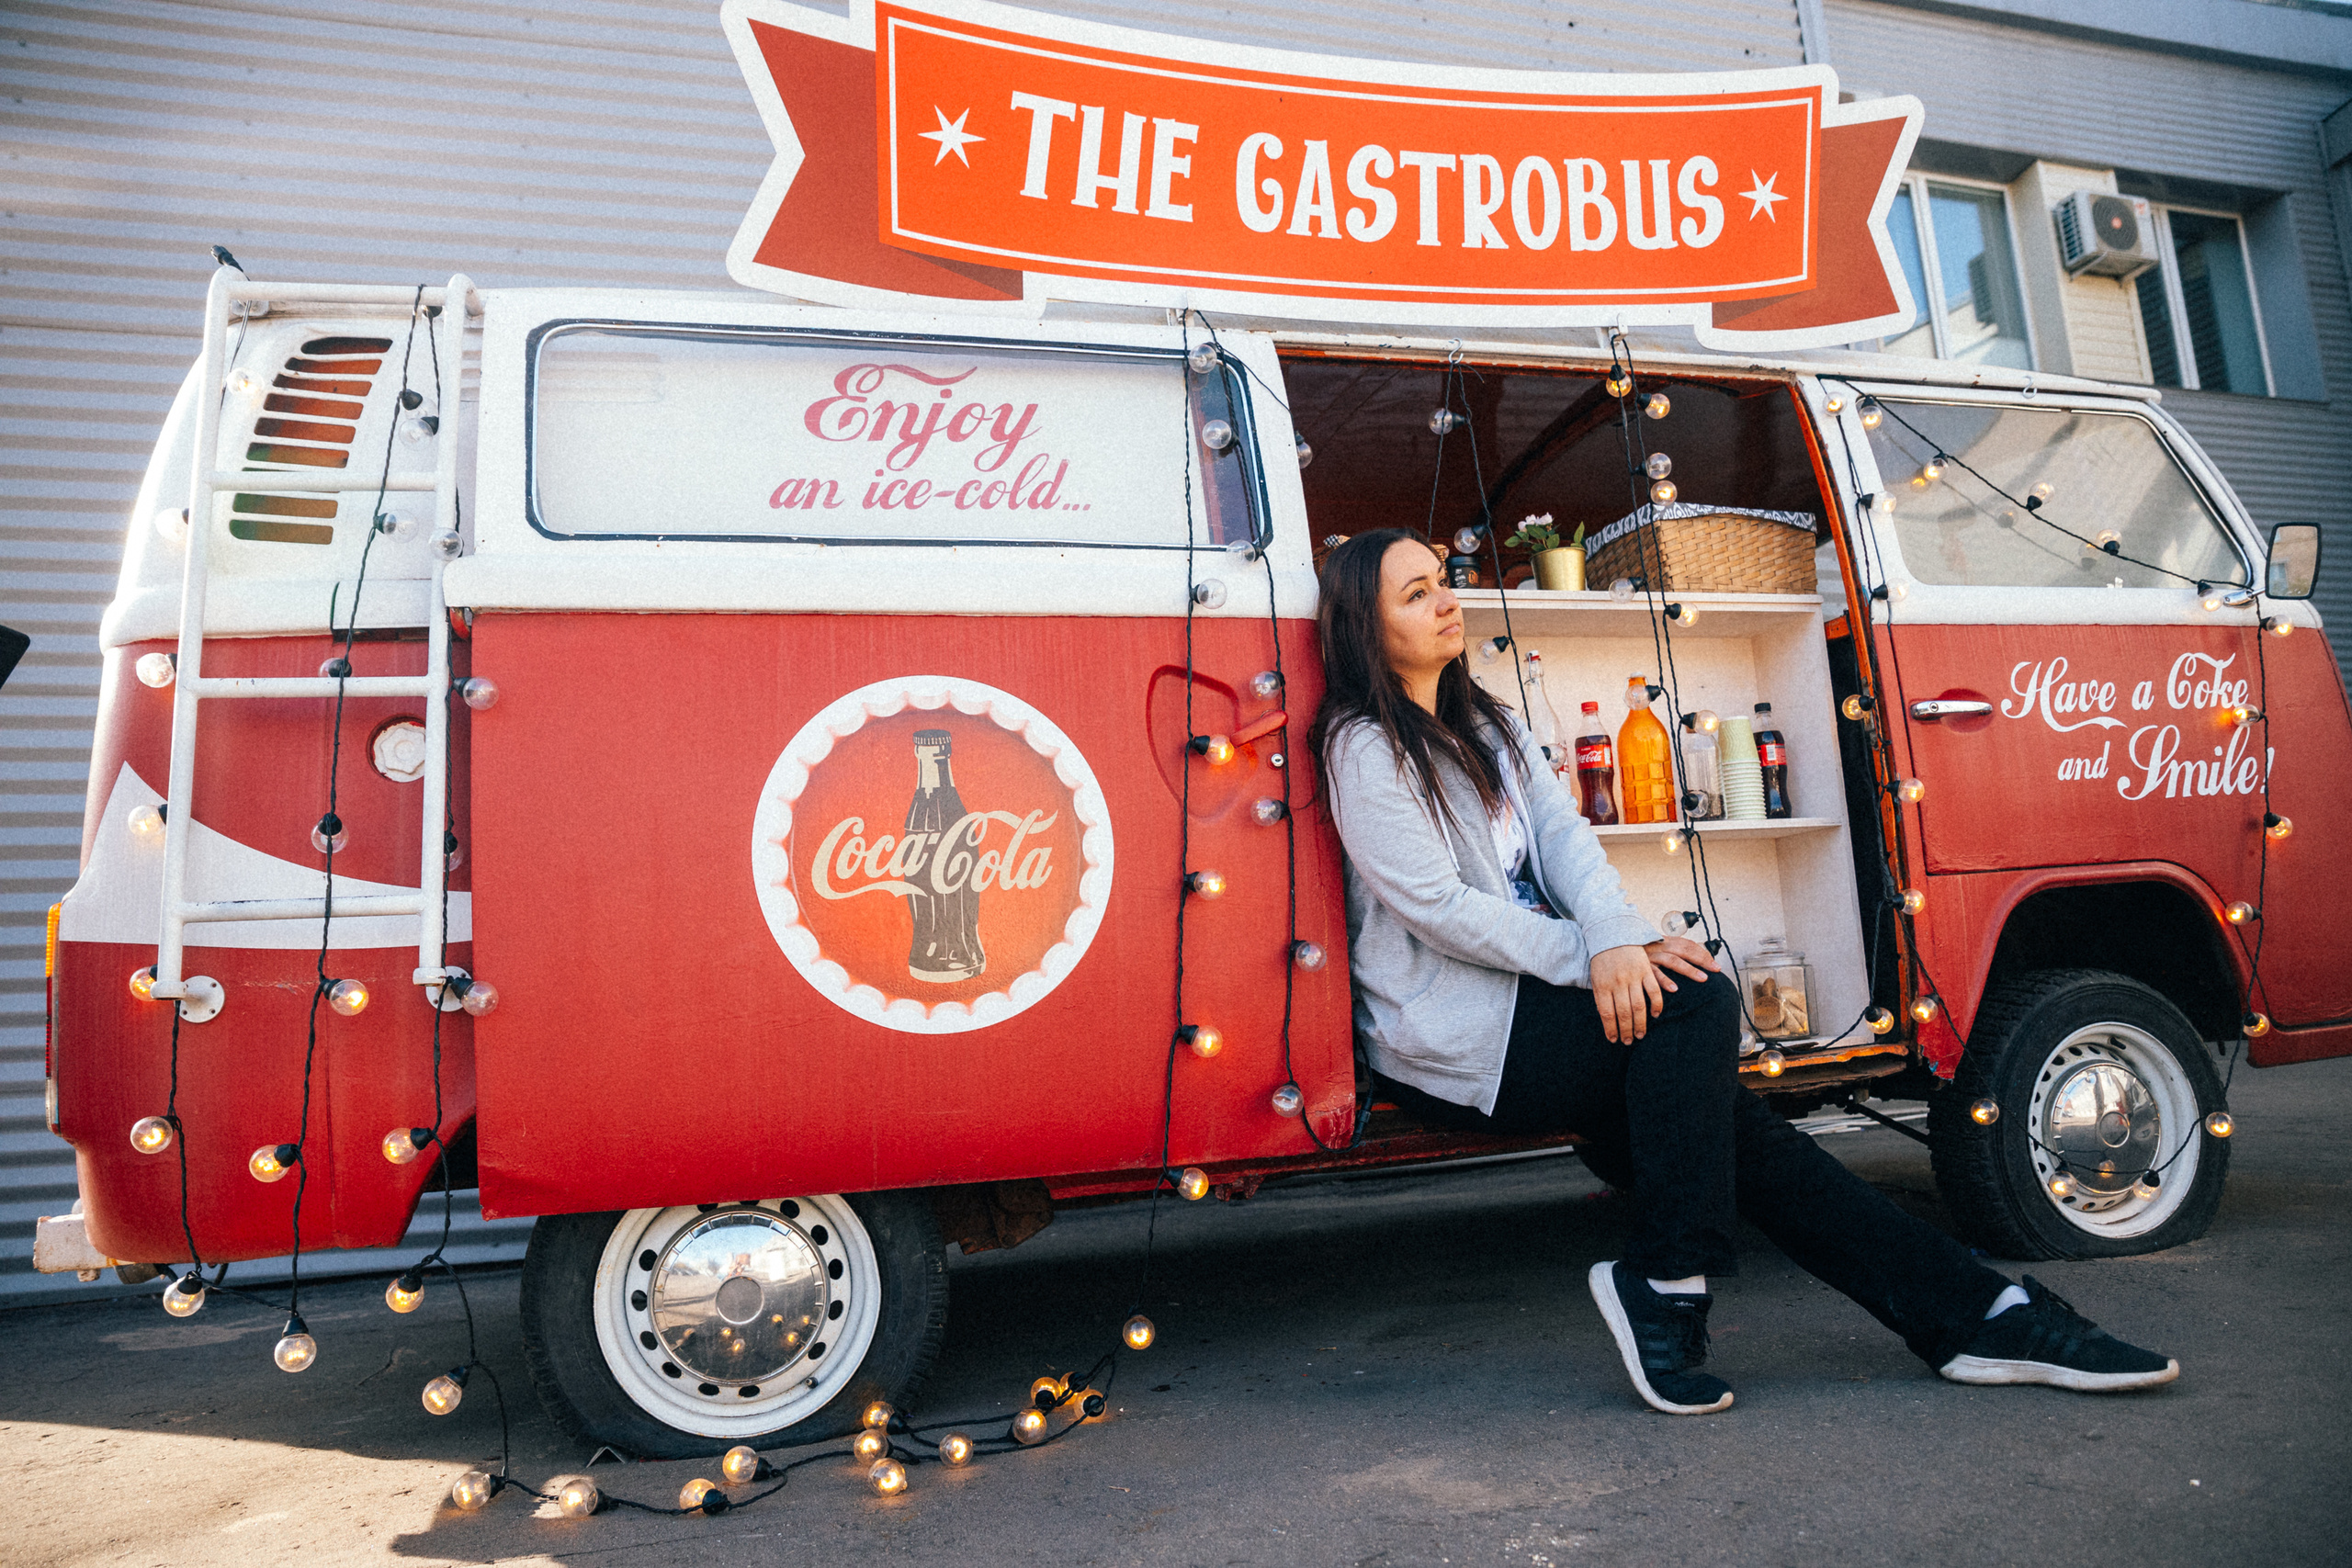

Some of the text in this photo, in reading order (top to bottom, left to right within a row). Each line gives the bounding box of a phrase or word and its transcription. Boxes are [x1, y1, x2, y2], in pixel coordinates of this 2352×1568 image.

[1010, 89, 1726, 252] THE GASTROBUS
[803, 363, 1043, 473] Enjoy
[768, 453, 1091, 511] an ice-cold...
[2000, 652, 2249, 733] Have a Coke
[2057, 724, 2276, 801] and Smile!
[811, 808, 1058, 900] Coca-Cola
